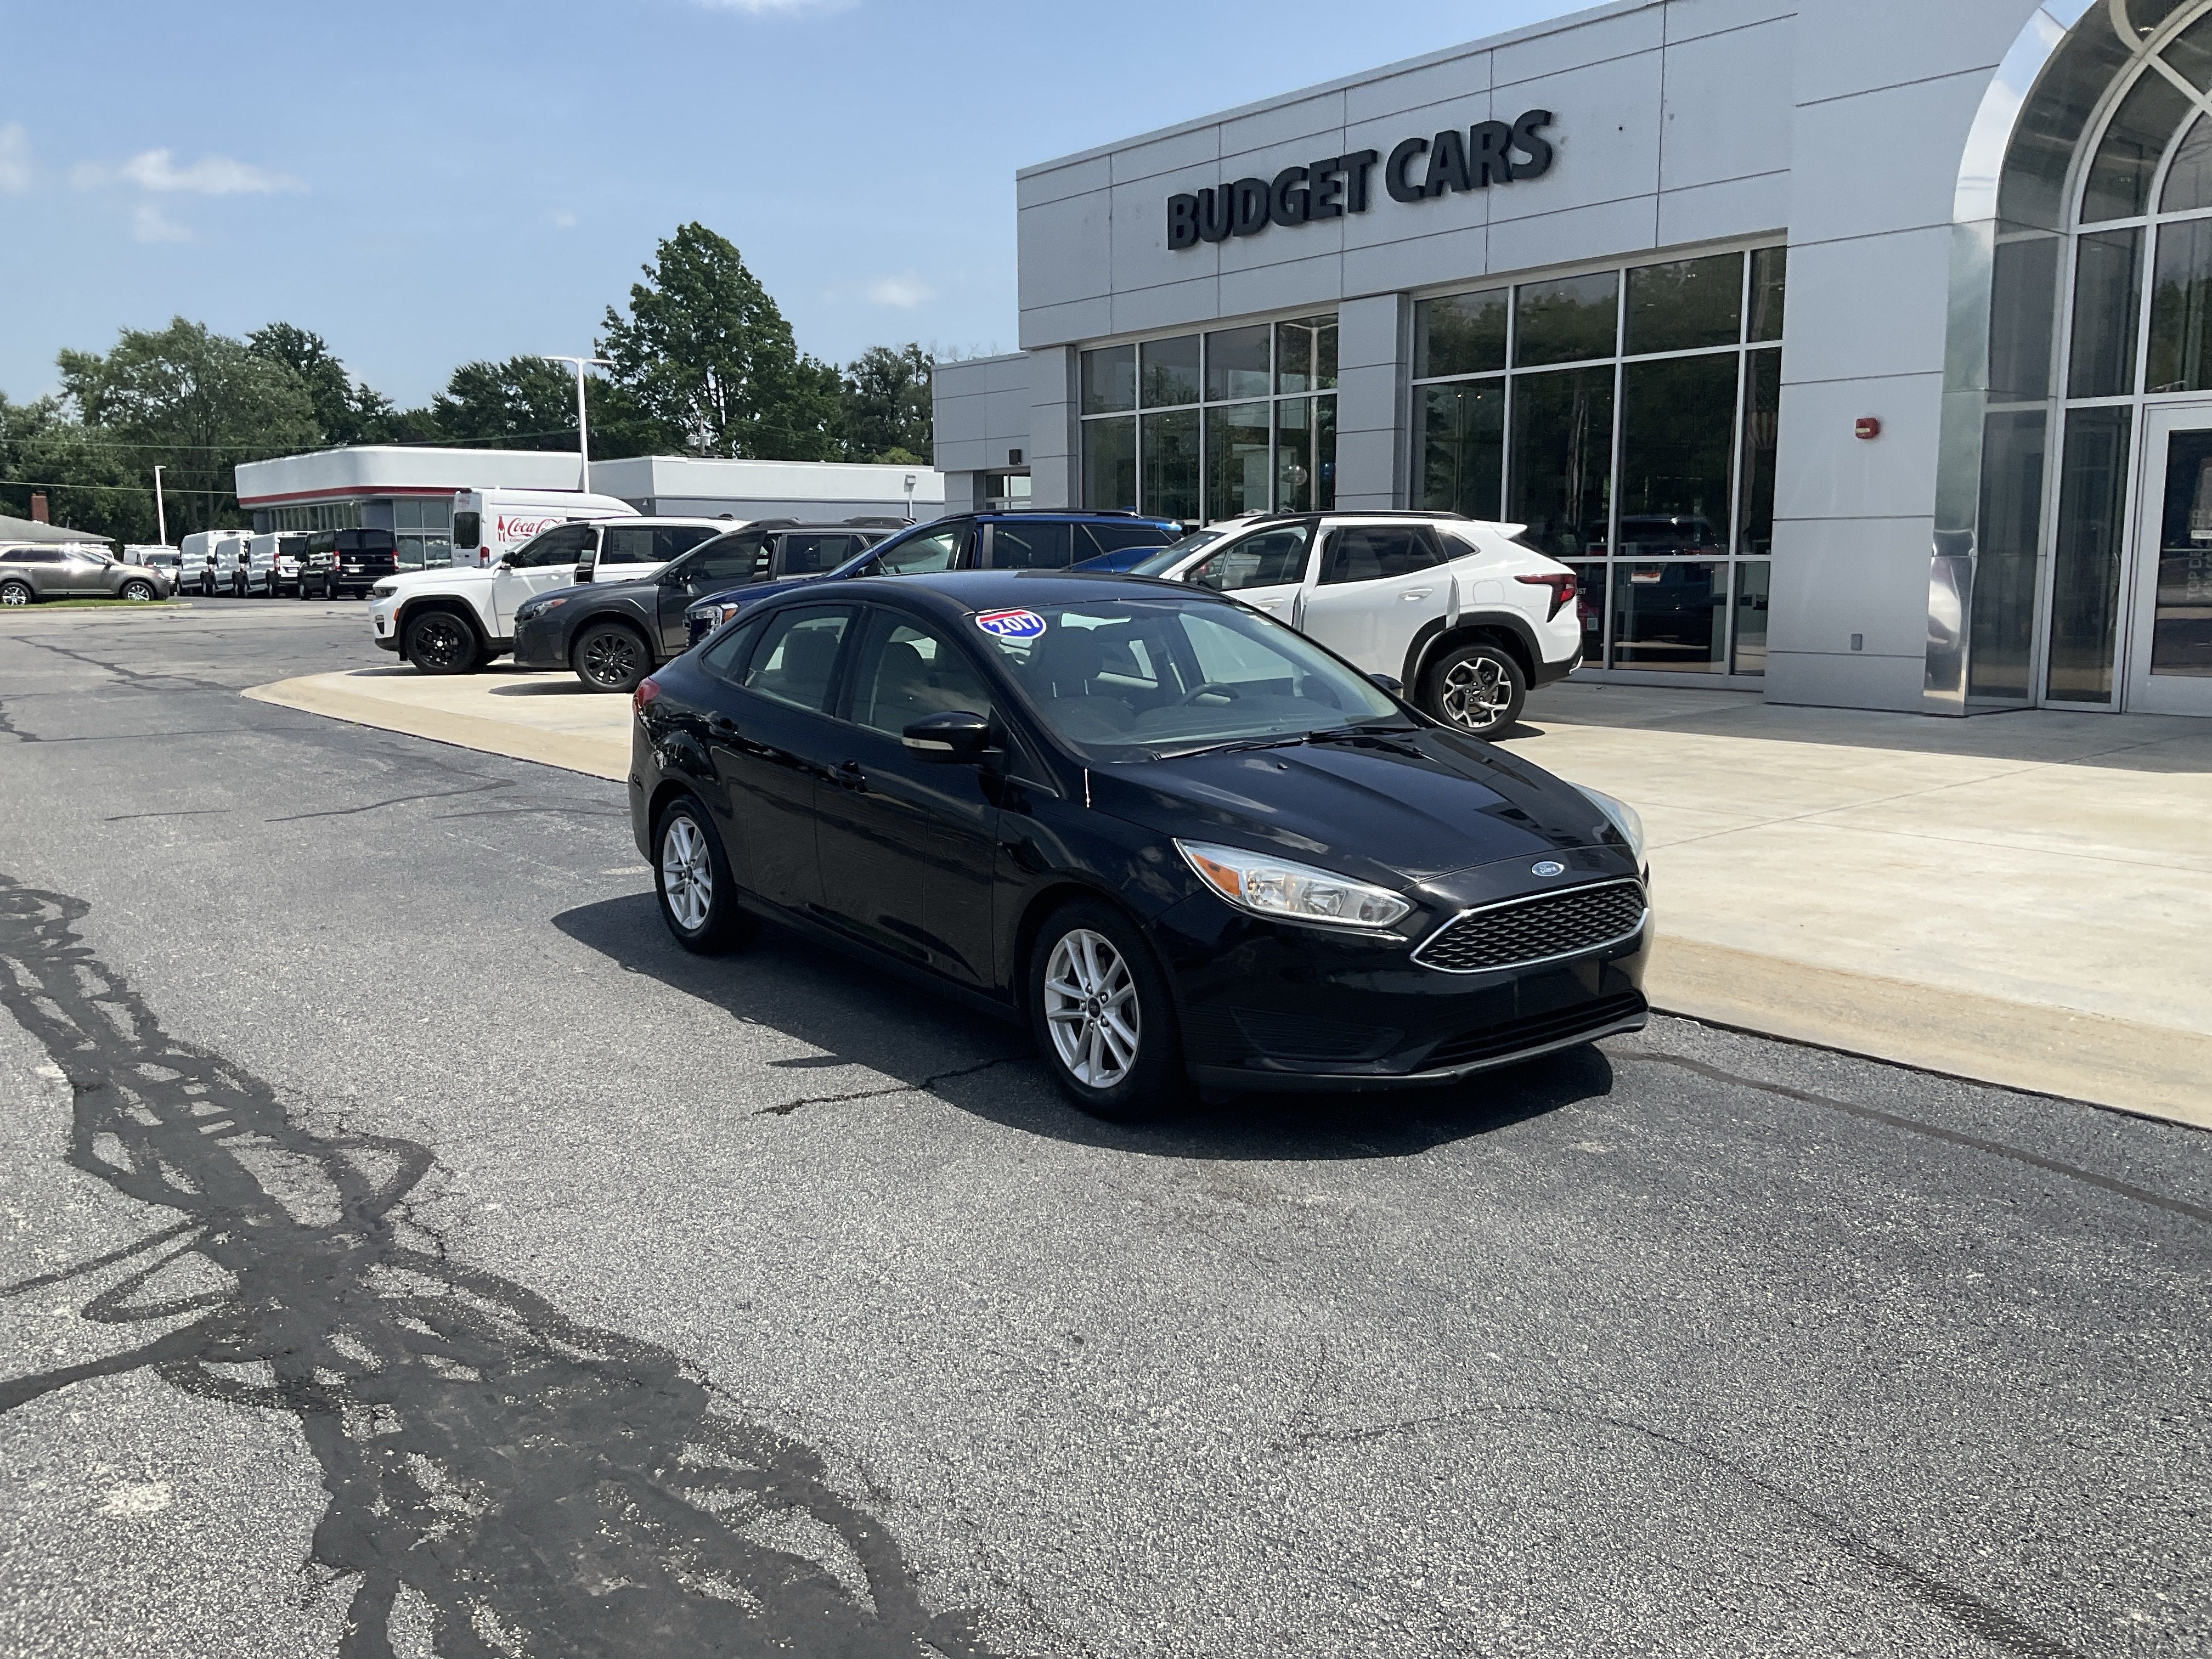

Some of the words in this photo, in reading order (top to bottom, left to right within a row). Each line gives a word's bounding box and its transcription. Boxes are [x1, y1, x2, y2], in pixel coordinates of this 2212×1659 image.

[1167, 149, 1378, 250] BUDGET
[1385, 109, 1553, 202] CARS
[2189, 509, 2205, 569] DEAER
[988, 614, 1040, 634] 2017
